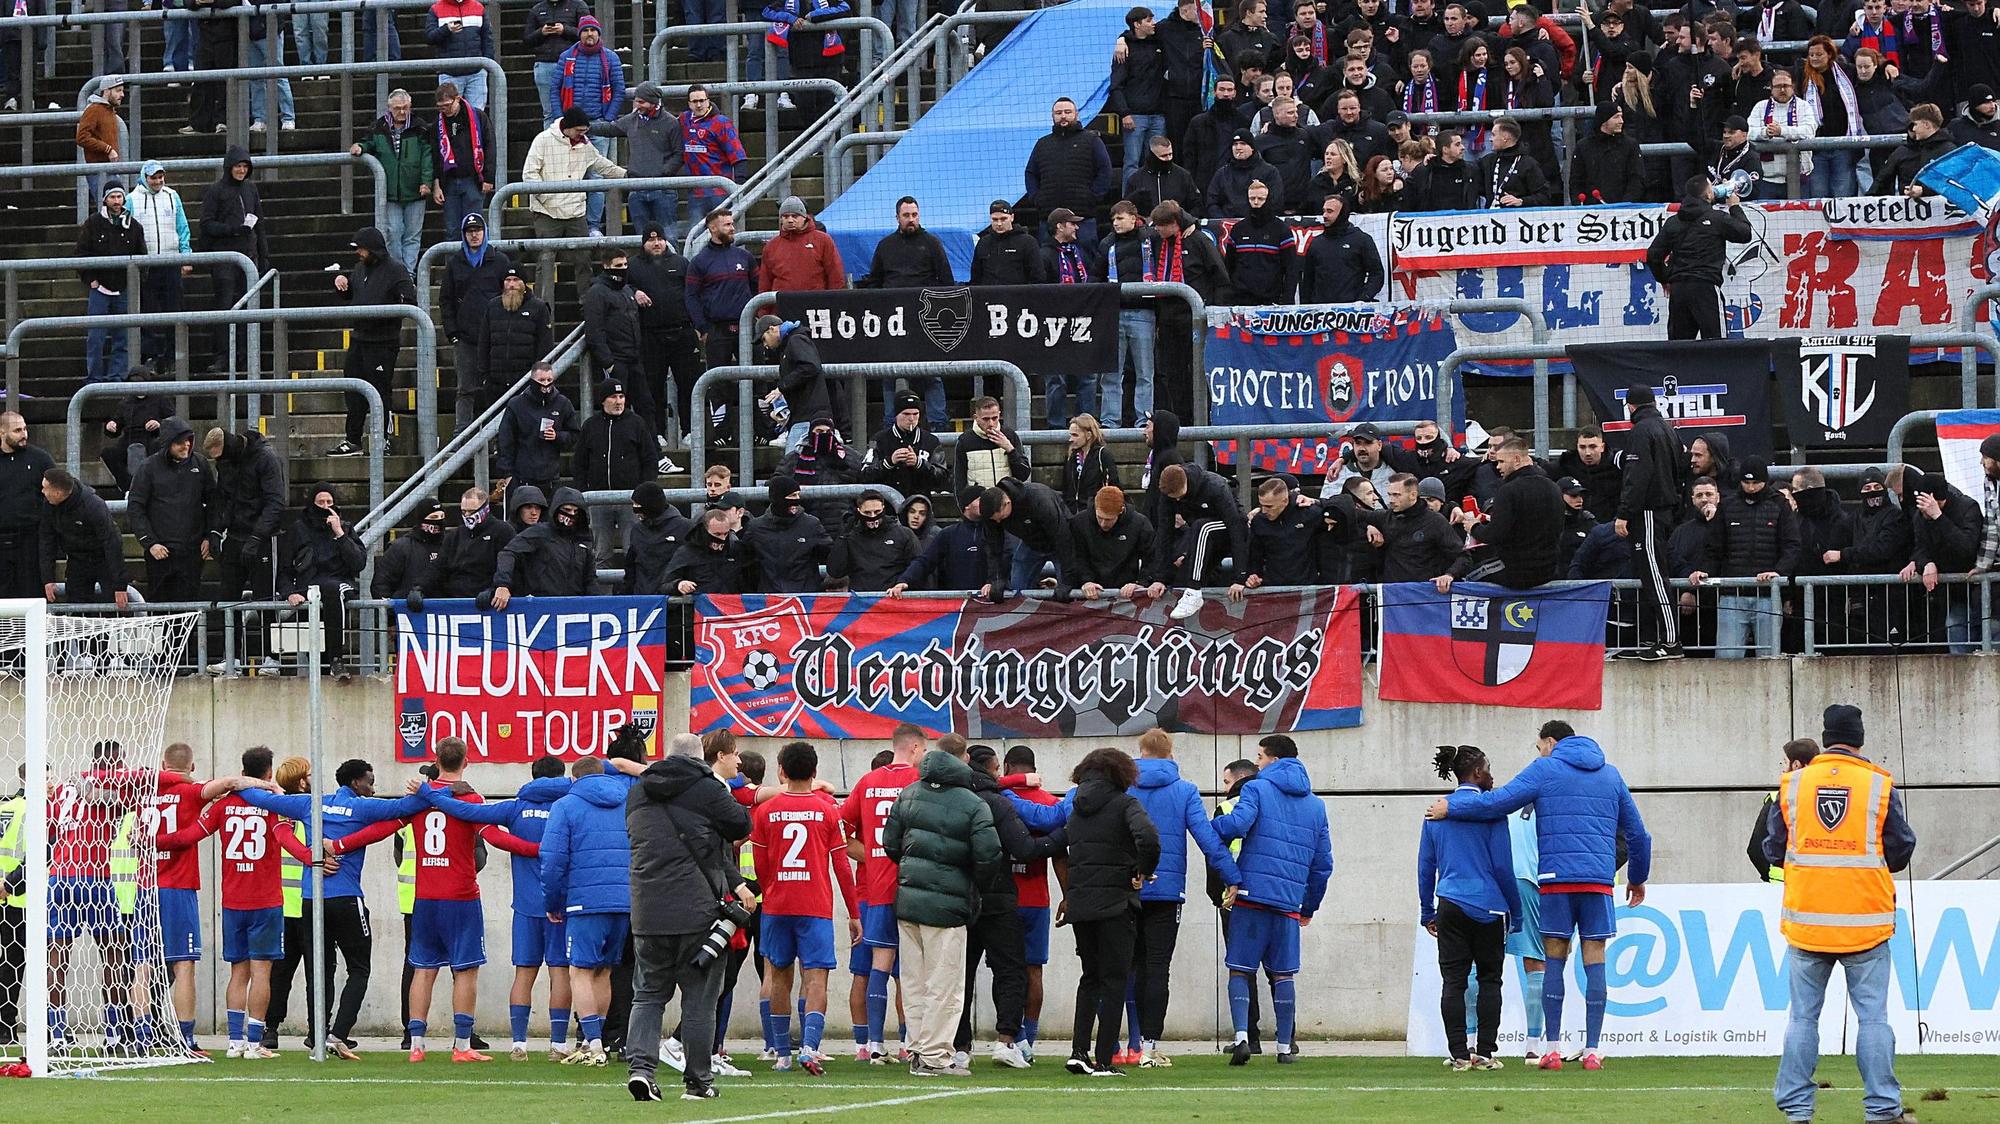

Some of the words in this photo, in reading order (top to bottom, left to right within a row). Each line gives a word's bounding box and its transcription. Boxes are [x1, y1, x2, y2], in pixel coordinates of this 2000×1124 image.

[1395, 216, 1507, 253] Jugend
[1518, 217, 1566, 244] der
[806, 306, 907, 340] Hood
[986, 302, 1093, 347] Boyz
[1263, 311, 1375, 333] JUNGFRONT
[1801, 335, 1841, 347] Kartell
[1845, 335, 1877, 347] 1905
[1207, 366, 1314, 410] GROTEN
[398, 607, 663, 697] NIEUKERK
[731, 621, 782, 650] KFC
[431, 710, 489, 757] ON
[516, 708, 627, 757] TOUR
[225, 815, 267, 861] 23
[424, 811, 447, 856] 8
[782, 822, 808, 868] 2
[1804, 838, 1857, 850] EINSATZLEITUNG
[777, 871, 812, 882] NGAMBIA
[1577, 1029, 1644, 1045] Tnsport
[1649, 1030, 1659, 1043] &
[1664, 1029, 1717, 1045] Logistik
[1723, 1029, 1767, 1043] GmbH
[1921, 1030, 2000, 1044] Wheels@W
